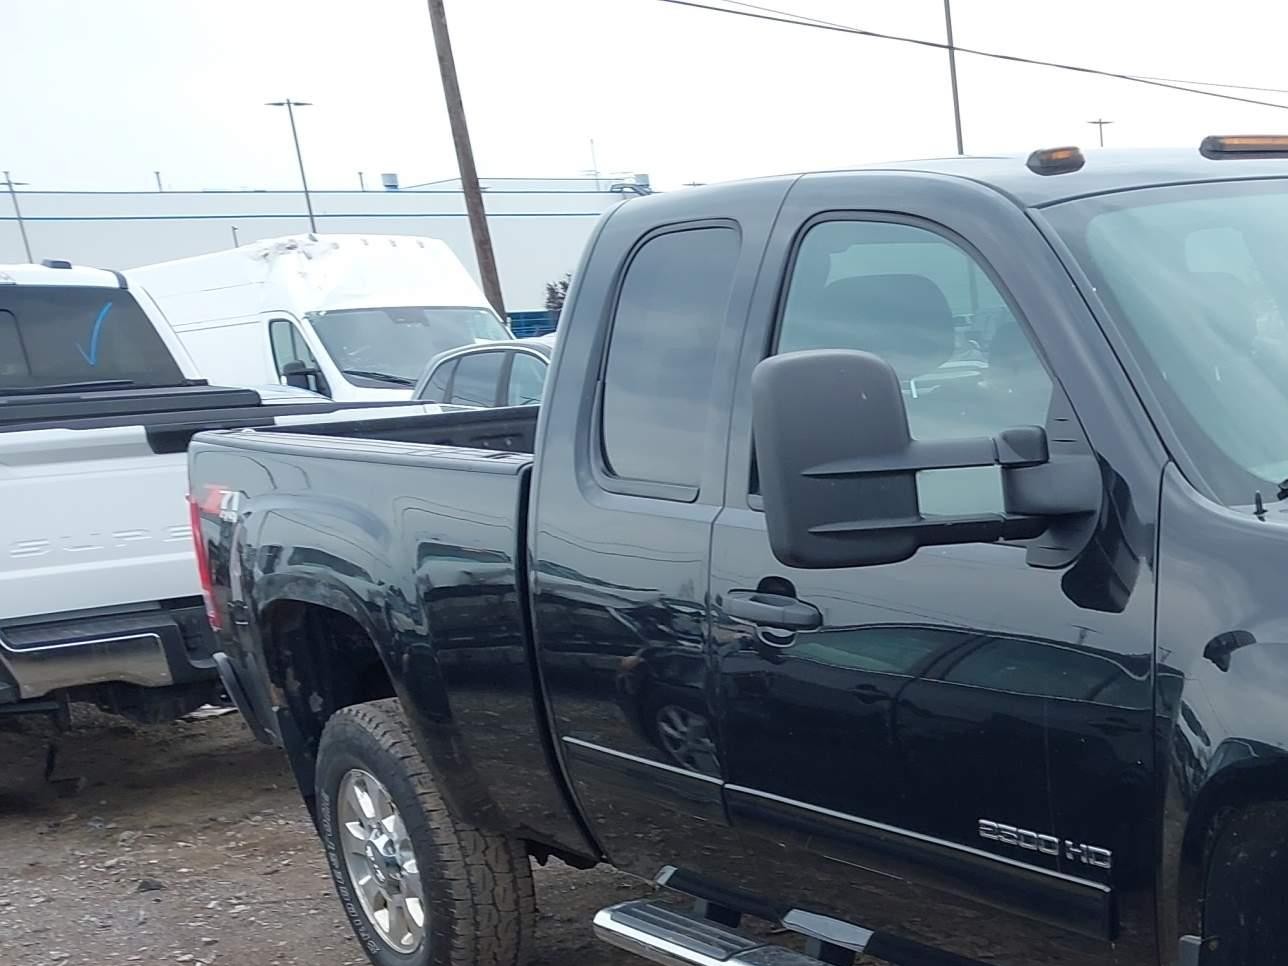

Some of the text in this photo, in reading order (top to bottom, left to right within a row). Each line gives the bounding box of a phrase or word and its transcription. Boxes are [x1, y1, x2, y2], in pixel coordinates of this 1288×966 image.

[9, 523, 193, 558] SUPE
[978, 819, 1112, 869] 2500 HD
